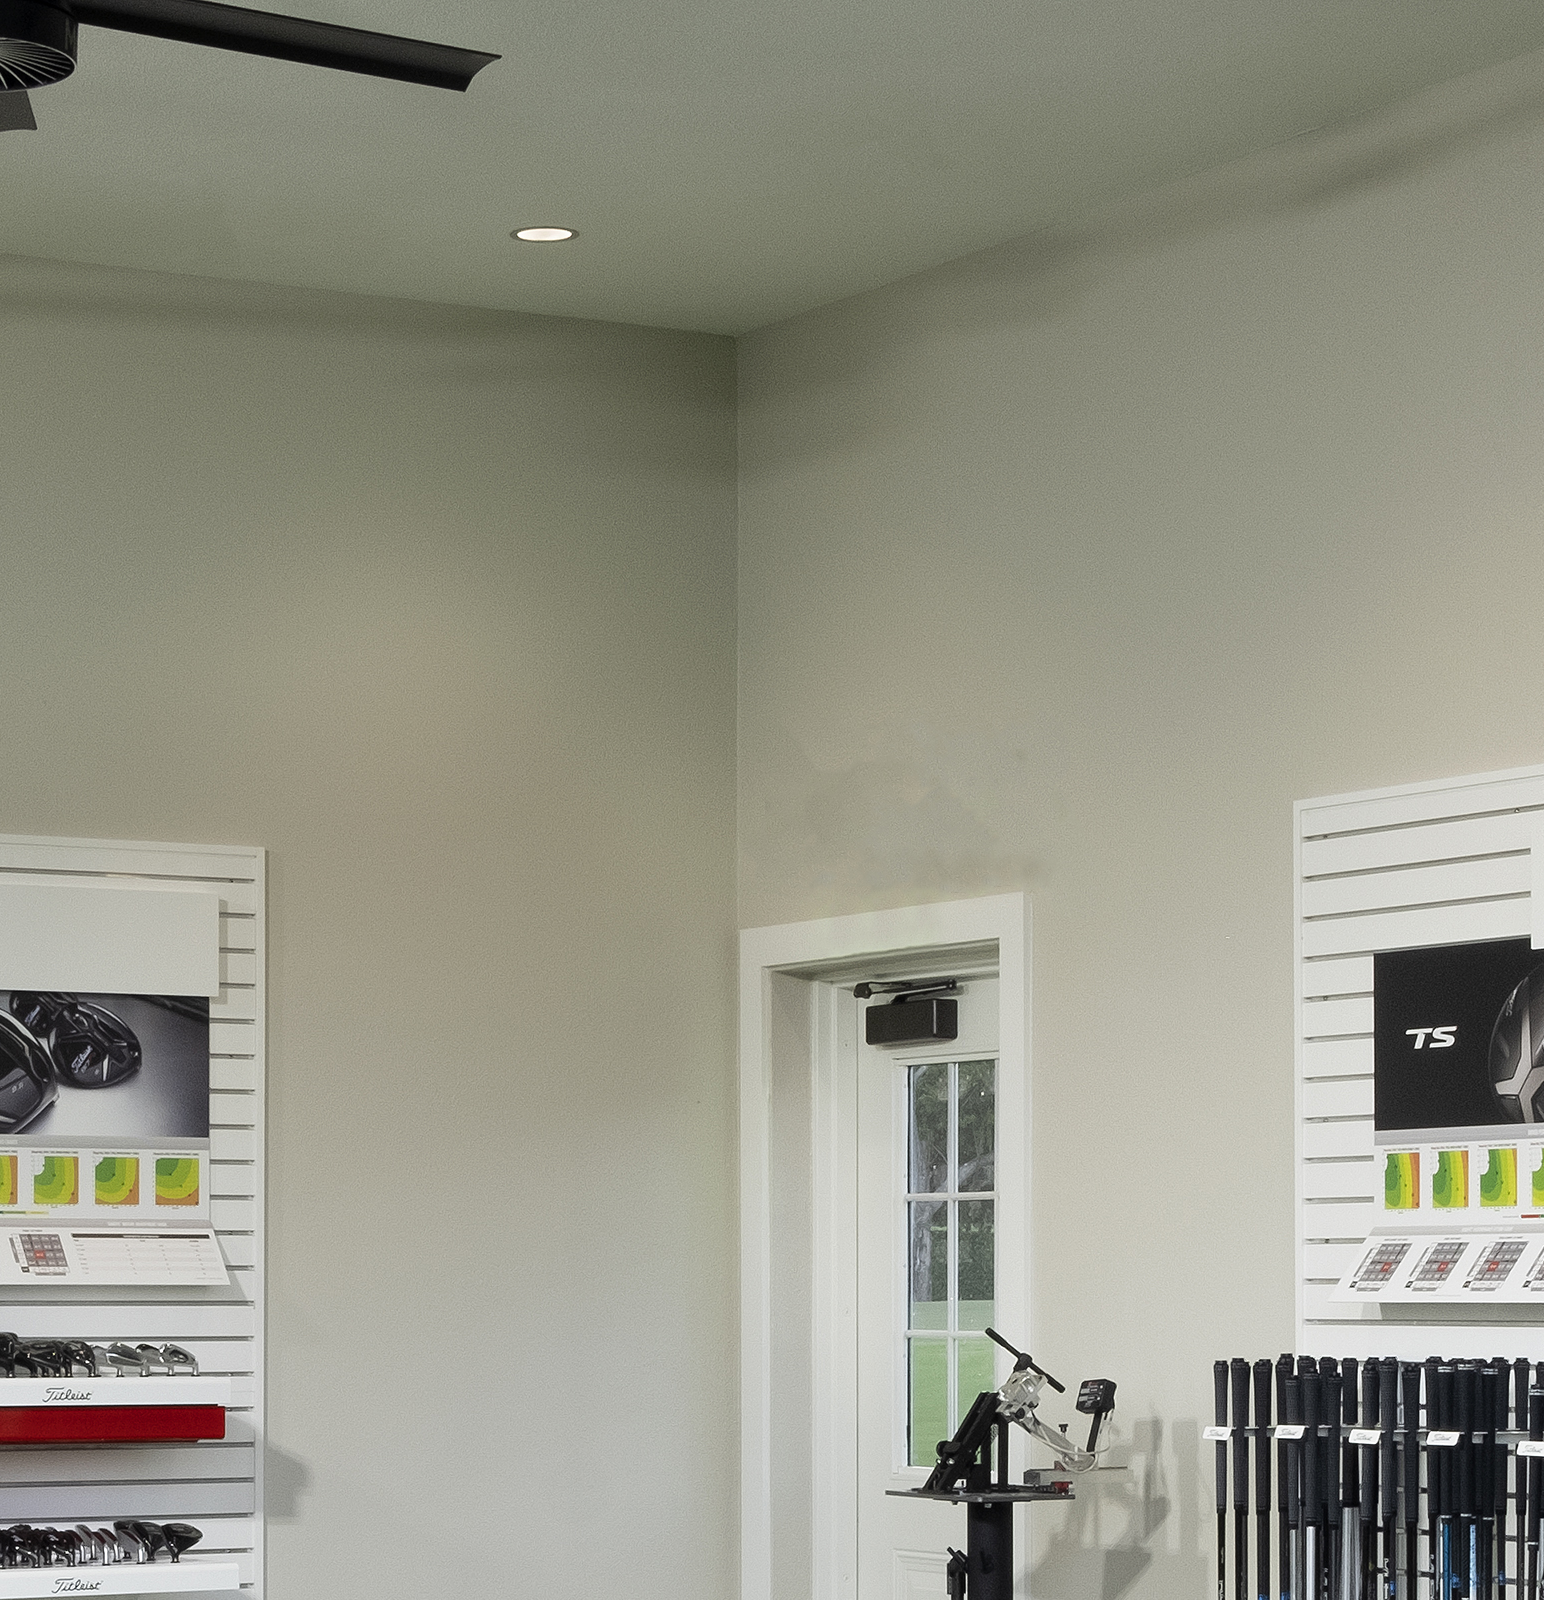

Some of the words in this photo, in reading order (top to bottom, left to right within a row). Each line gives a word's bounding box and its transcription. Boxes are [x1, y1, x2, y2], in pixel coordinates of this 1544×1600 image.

[1405, 1025, 1458, 1050] TS
[42, 1386, 93, 1403] Titleist
[51, 1577, 102, 1594] Titleist
